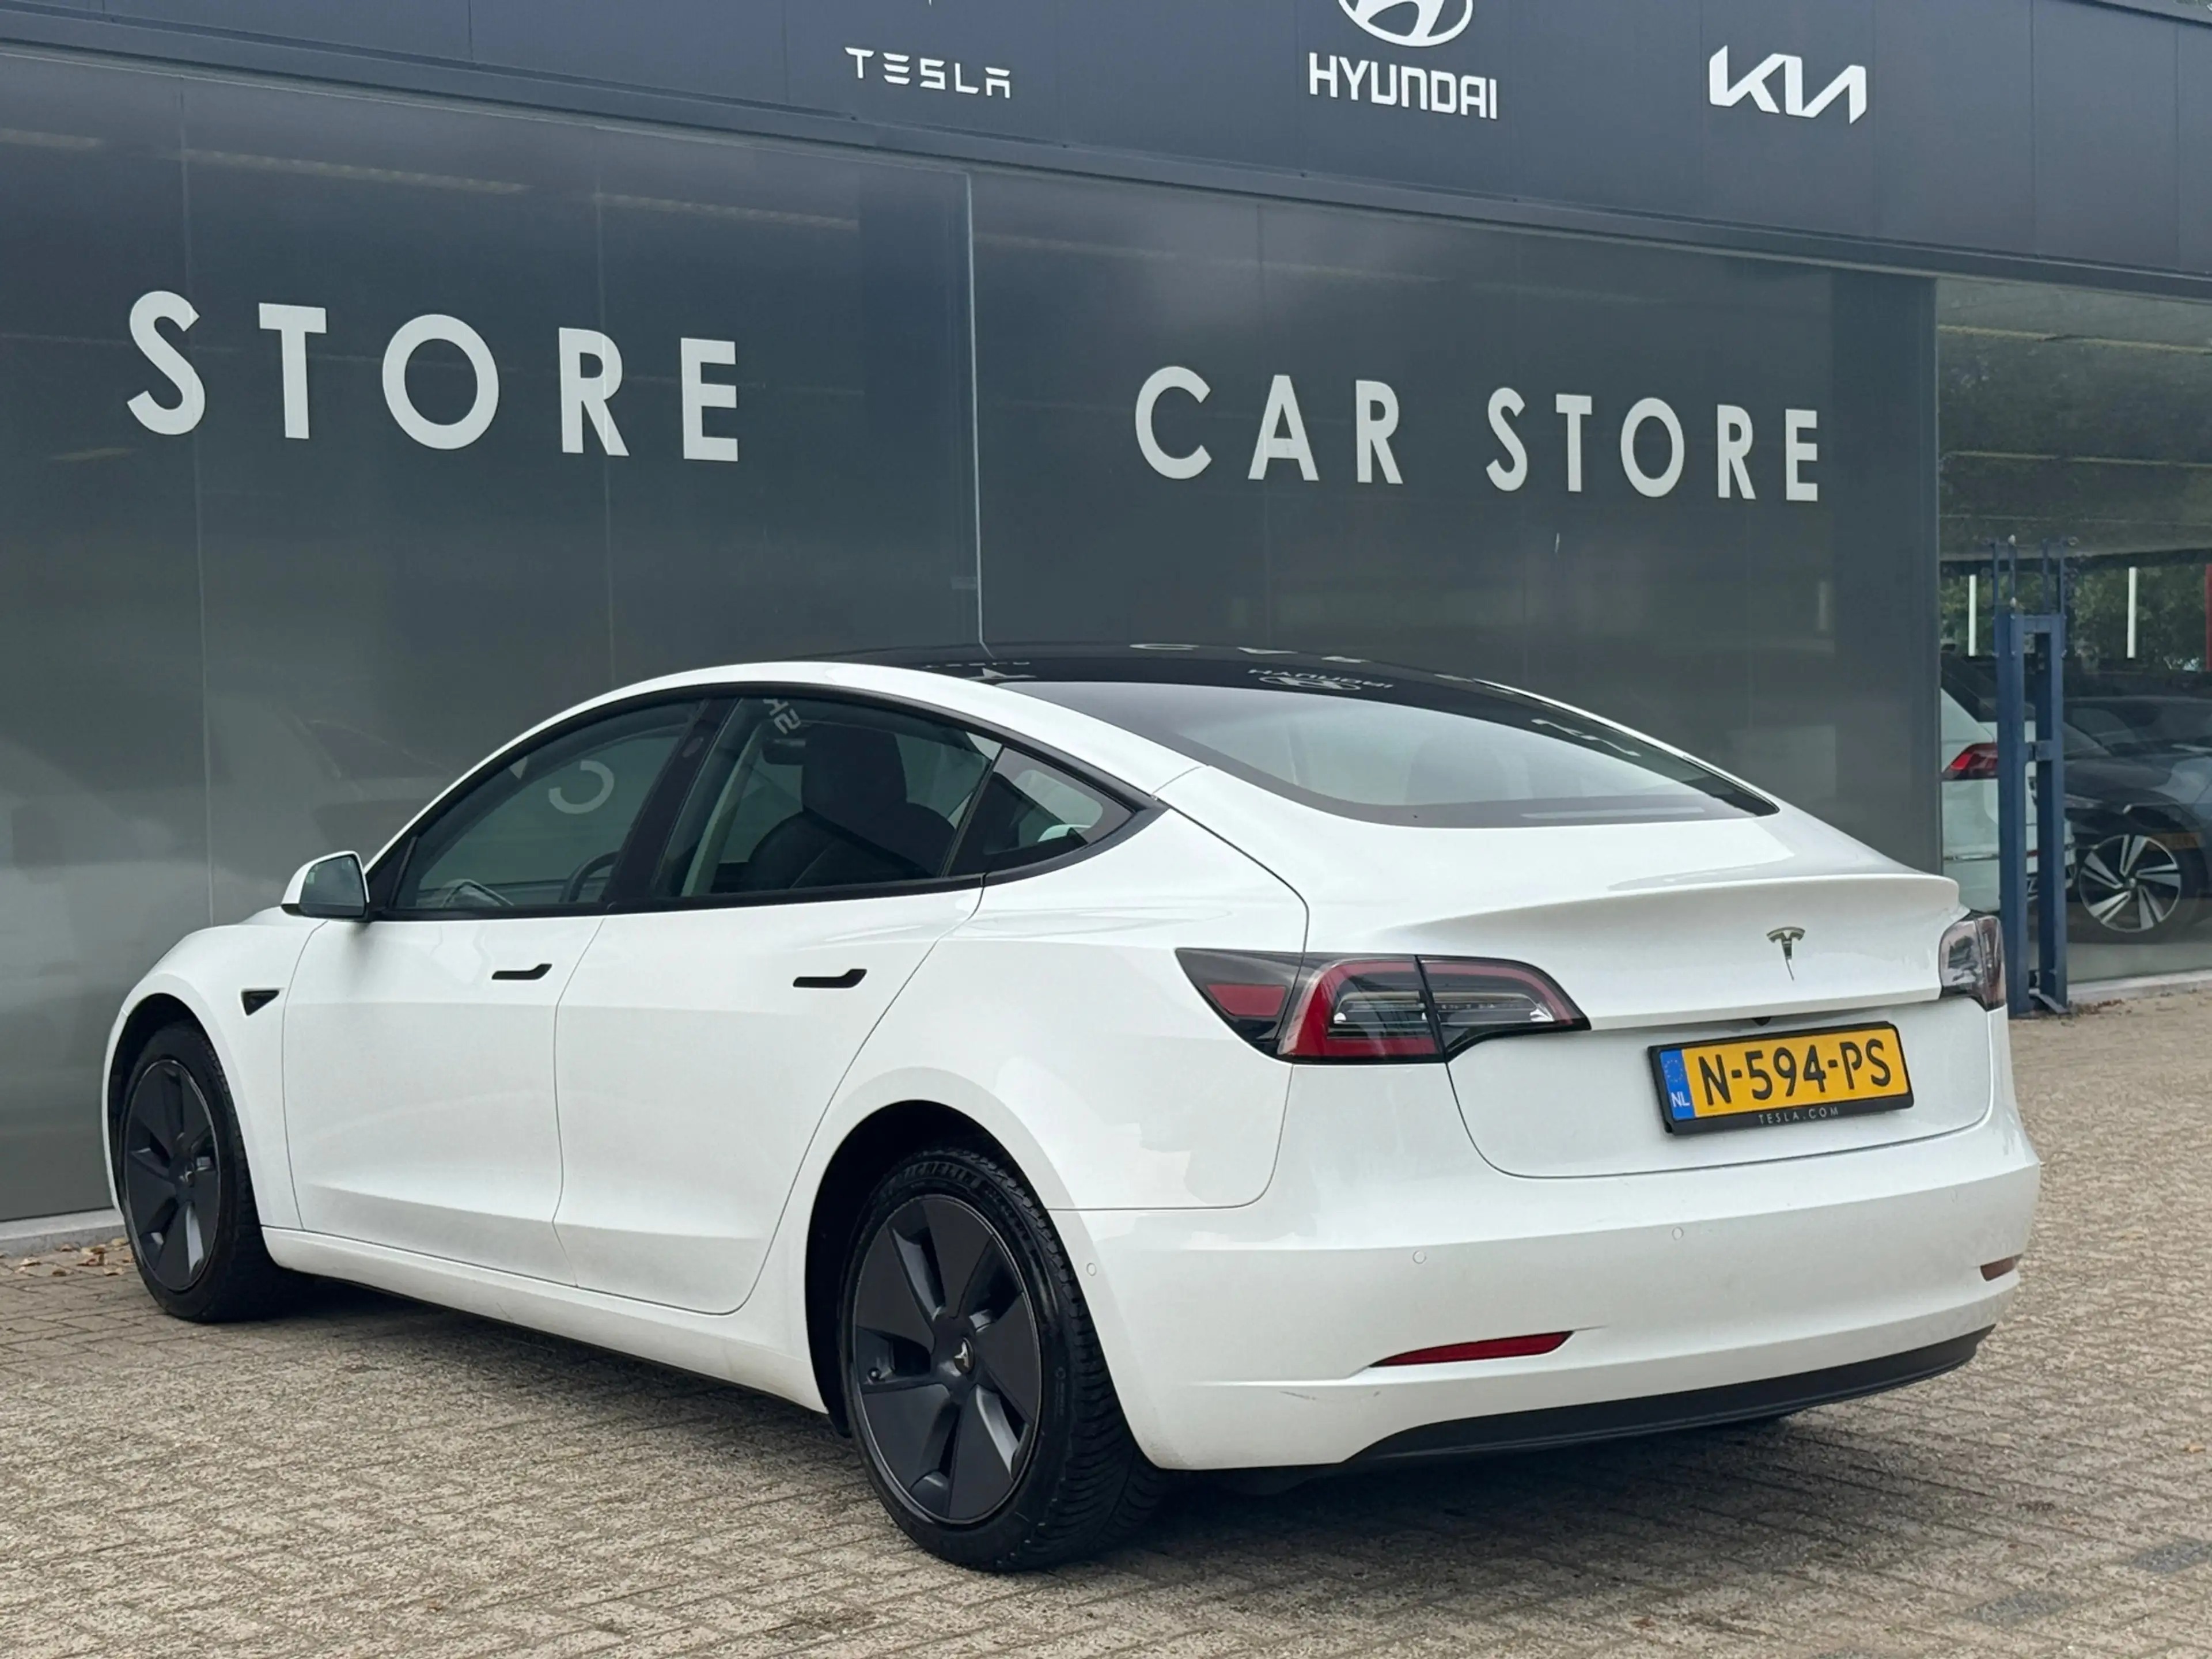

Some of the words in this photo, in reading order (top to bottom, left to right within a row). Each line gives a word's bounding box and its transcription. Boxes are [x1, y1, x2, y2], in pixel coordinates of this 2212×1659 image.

[844, 47, 1010, 99] TESLA
[1309, 52, 1497, 119] HYUNDAI
[1709, 45, 1867, 124] KIA
[127, 291, 738, 462] STORE
[1135, 366, 1403, 484] CAR
[1486, 387, 1818, 502] STORE
[1671, 1090, 1691, 1108] NL
[1699, 1039, 1891, 1105] N-594-PS
[1758, 1106, 1839, 1125] TESLA.COM
